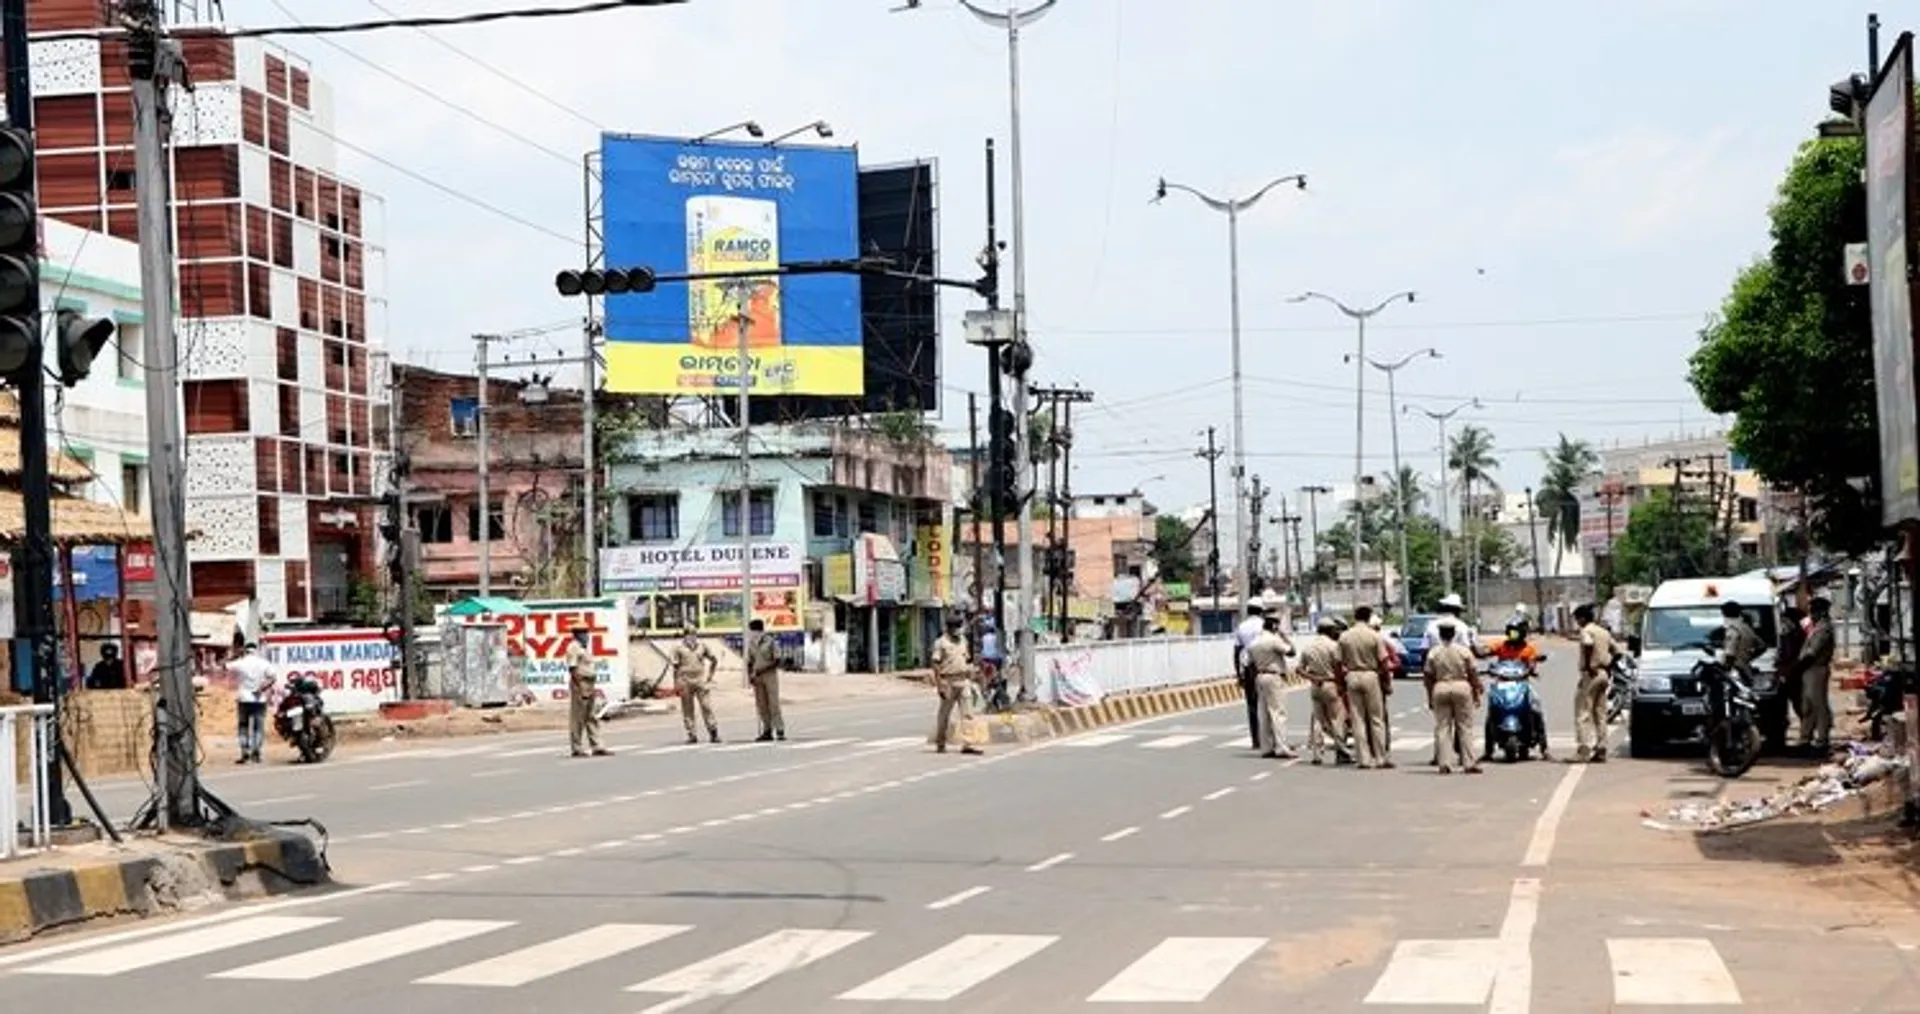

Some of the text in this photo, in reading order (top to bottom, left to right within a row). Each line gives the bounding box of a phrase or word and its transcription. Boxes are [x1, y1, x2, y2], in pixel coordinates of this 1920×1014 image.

[714, 238, 772, 253] RAMCO
[640, 549, 705, 564] HOTEL
[287, 644, 335, 664] KALYAN
